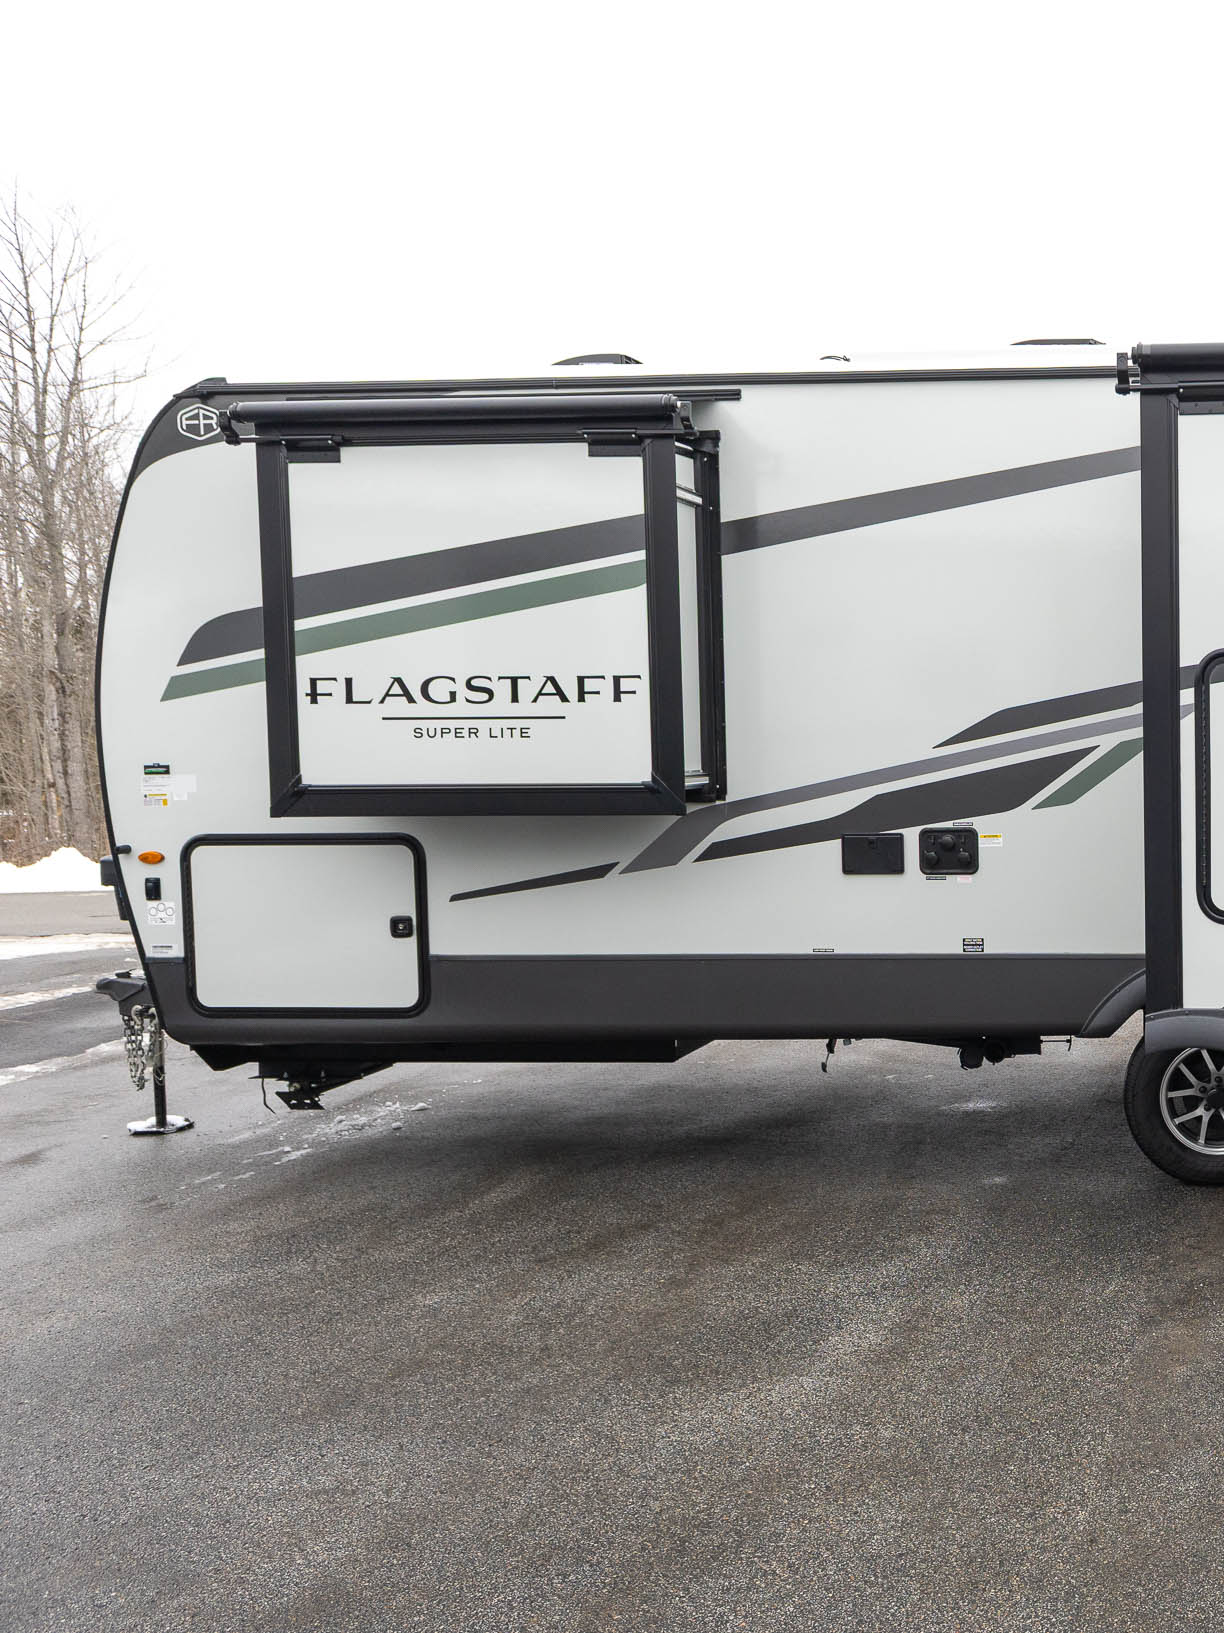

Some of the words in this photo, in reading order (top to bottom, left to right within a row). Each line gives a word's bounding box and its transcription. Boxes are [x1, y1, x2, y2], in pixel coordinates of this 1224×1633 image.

[305, 674, 643, 705] FLAGSTAFF
[413, 727, 480, 739] SUPER
[489, 727, 532, 739] LITE
